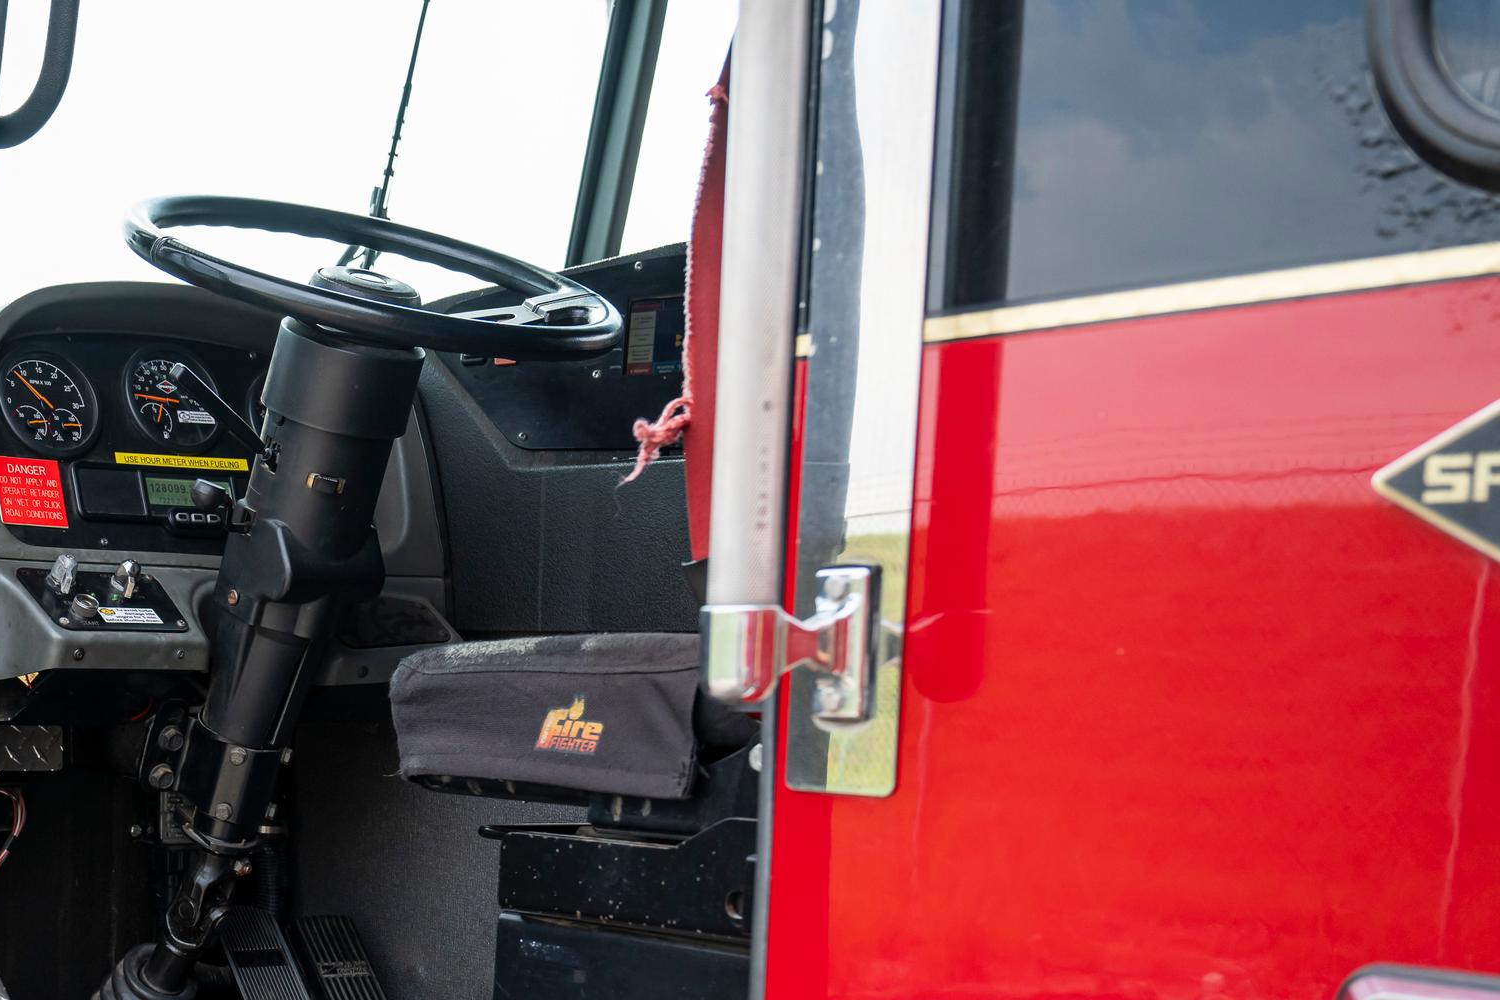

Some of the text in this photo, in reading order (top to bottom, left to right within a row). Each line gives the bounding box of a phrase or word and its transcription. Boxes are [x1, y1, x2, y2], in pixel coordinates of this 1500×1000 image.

[7, 464, 46, 475] DANGER
[26, 478, 43, 486] APPLY
[2, 487, 59, 498] OPERATE RETARDER
[4, 497, 12, 505] ON
[44, 501, 61, 509] SLICK
[5, 508, 63, 520] ROAD CONDITIONS
[536, 703, 603, 749] Fire
[549, 737, 596, 752] FIGHTER
